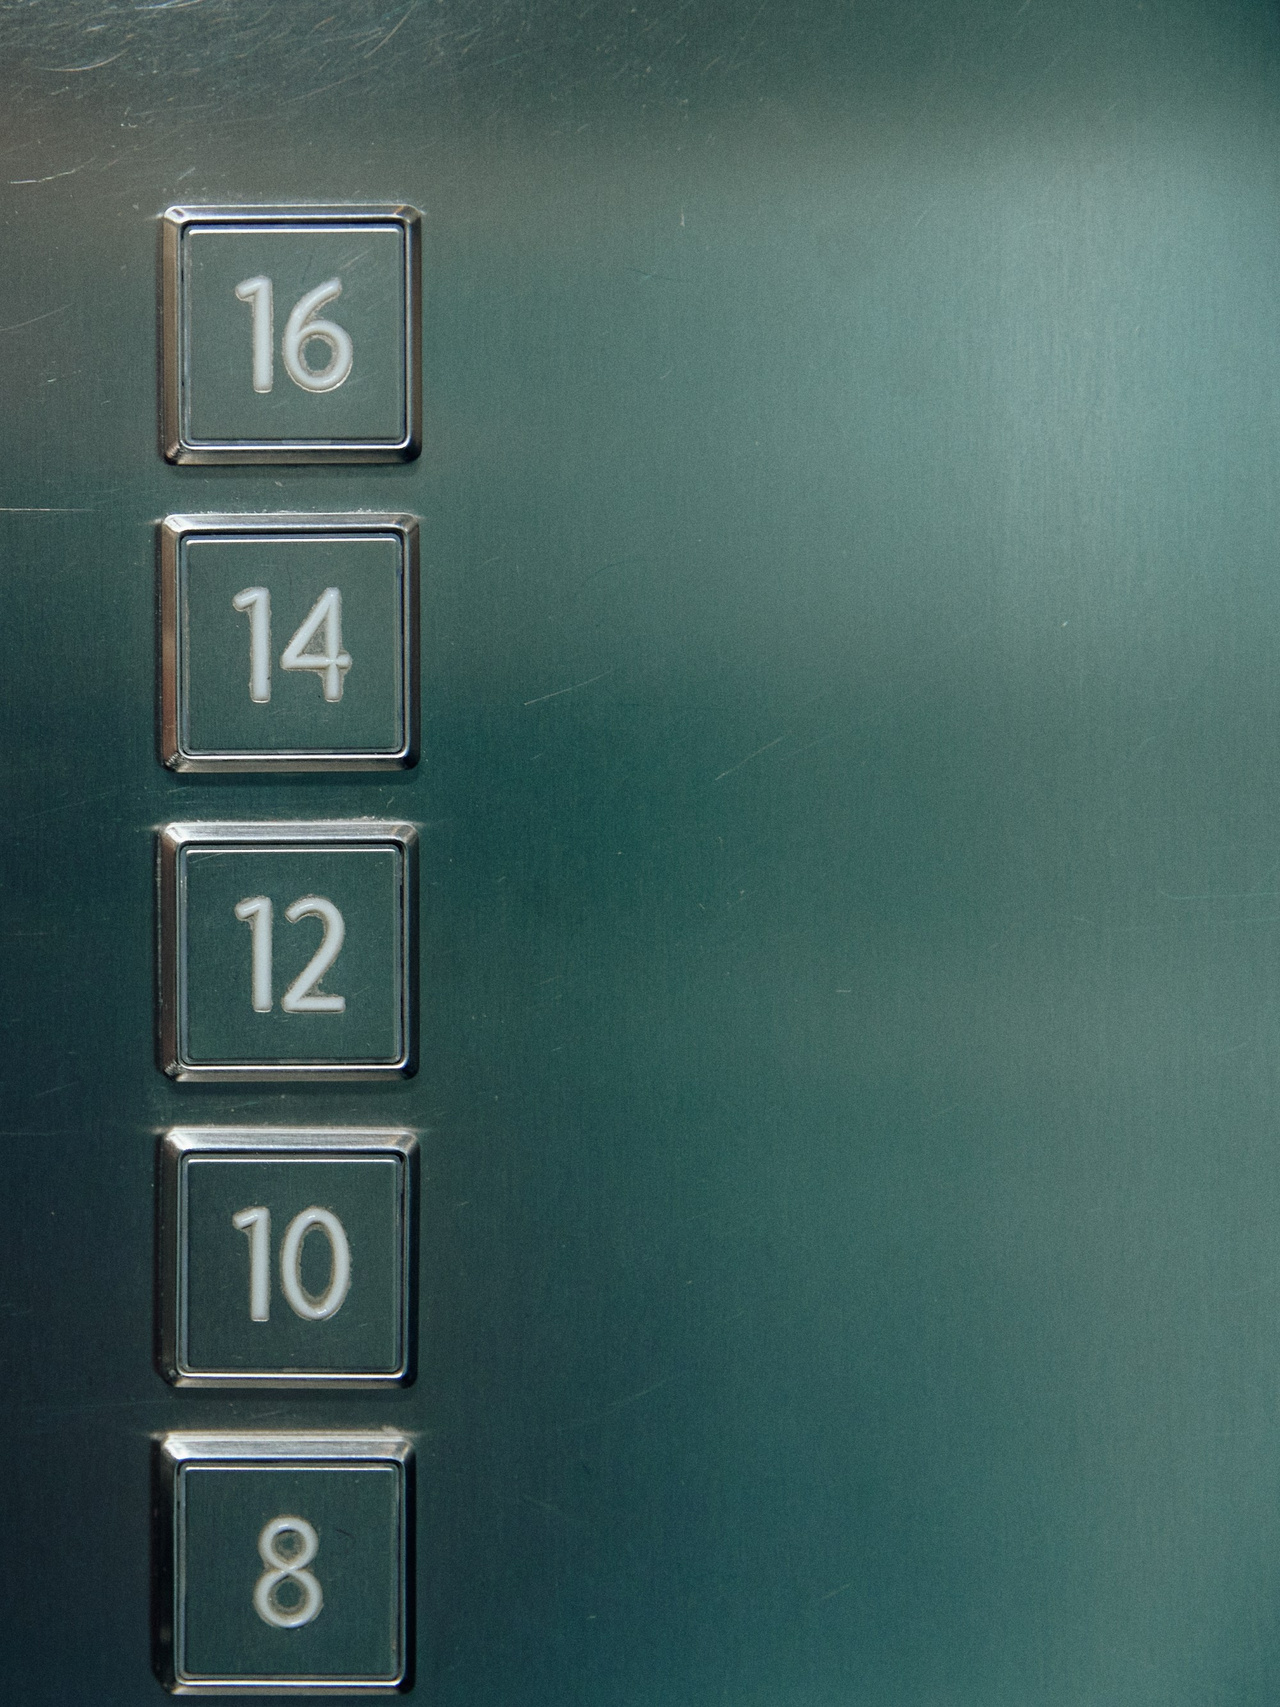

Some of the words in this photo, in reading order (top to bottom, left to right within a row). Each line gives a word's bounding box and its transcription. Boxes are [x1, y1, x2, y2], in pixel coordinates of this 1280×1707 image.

[234, 274, 354, 395] 16
[232, 586, 353, 705] 14
[234, 895, 347, 1015] 12
[232, 1206, 351, 1323] 10
[254, 1516, 322, 1629] 8
